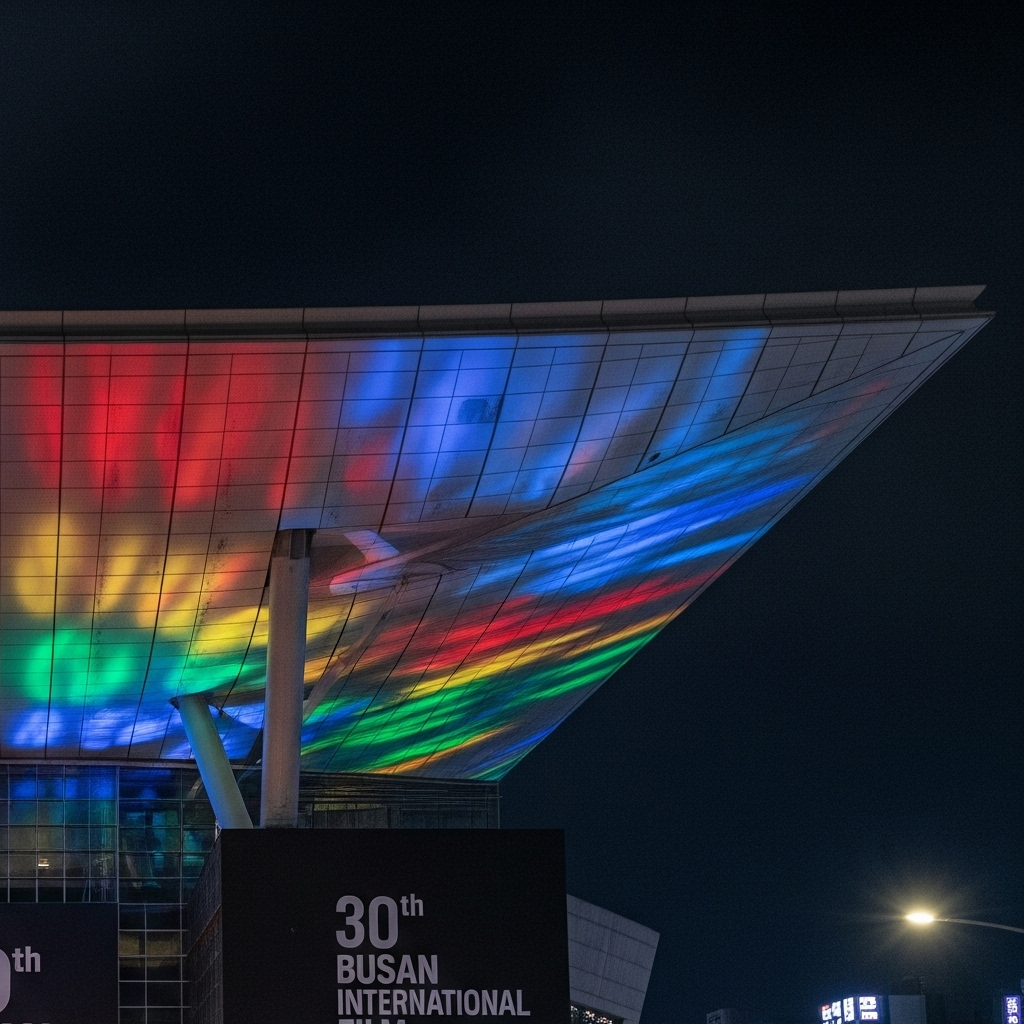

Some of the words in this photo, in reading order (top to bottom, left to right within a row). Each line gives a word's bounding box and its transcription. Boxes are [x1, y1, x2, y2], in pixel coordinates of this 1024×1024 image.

[335, 893, 424, 949] 30th
[336, 954, 439, 985] BUSAN
[337, 989, 531, 1017] INTERNATIONAL
